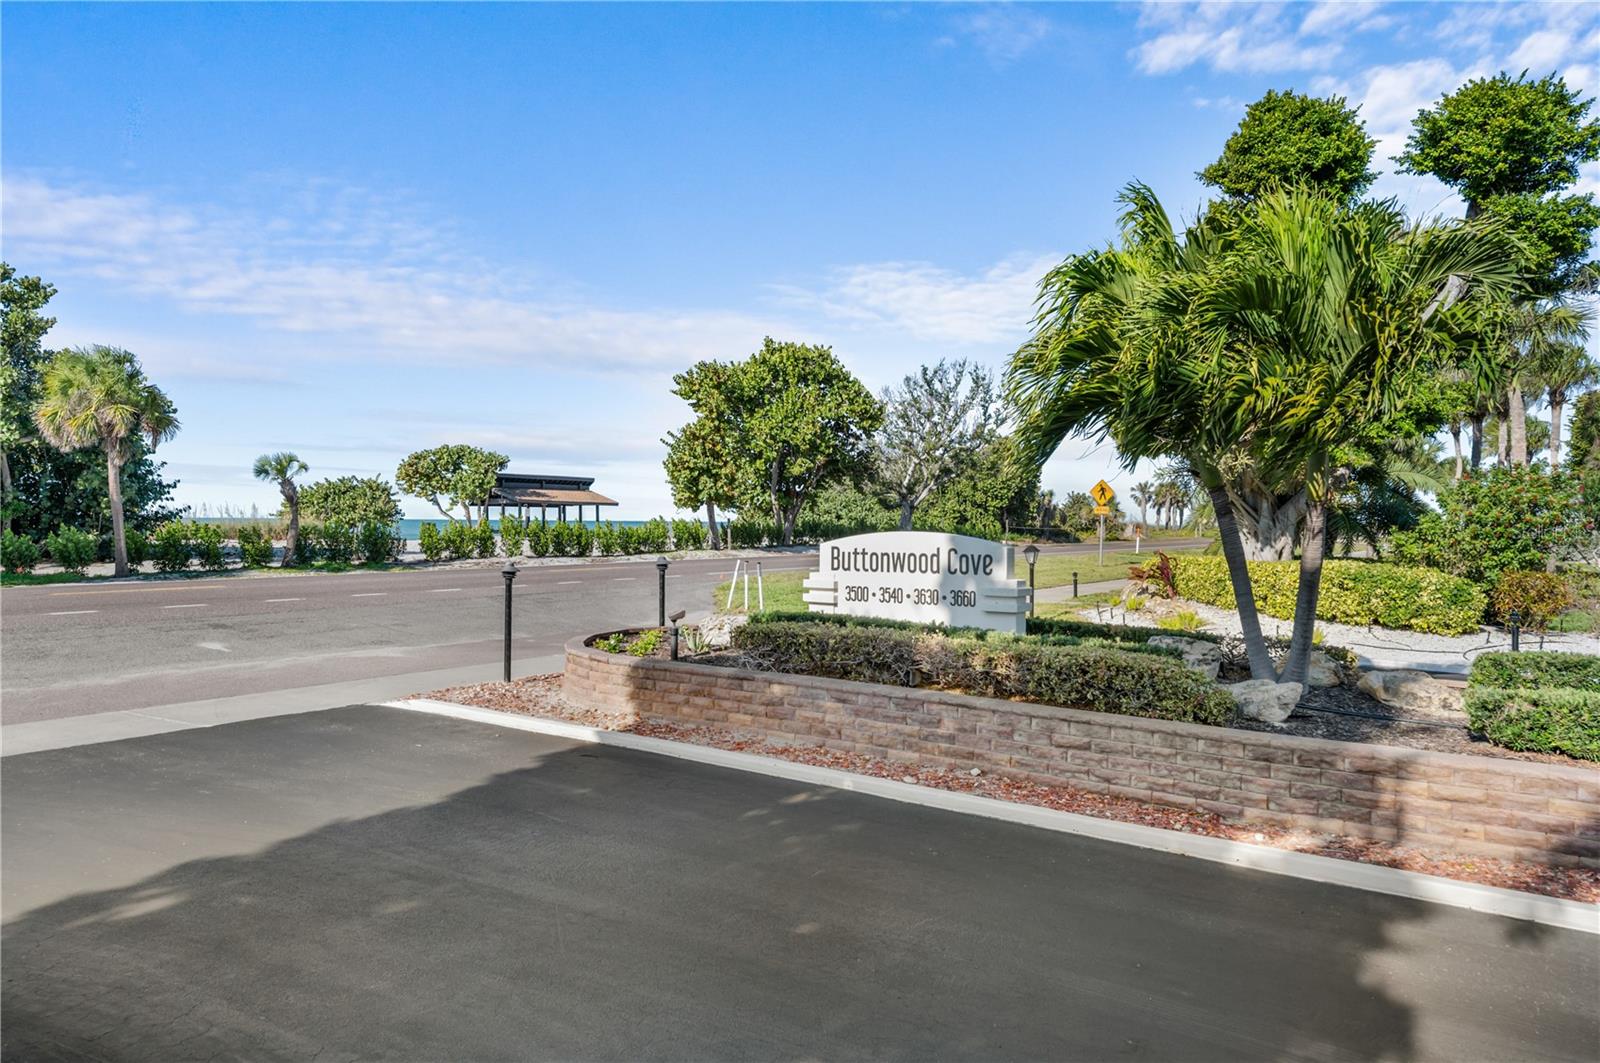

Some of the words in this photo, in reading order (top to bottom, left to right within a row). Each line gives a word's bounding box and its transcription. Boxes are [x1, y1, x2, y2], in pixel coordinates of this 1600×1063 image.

[831, 546, 941, 574] Buttonwood
[947, 547, 993, 576] Cove
[845, 585, 869, 602] 3500
[879, 586, 903, 604] 3540
[913, 588, 939, 606] 3630
[950, 589, 976, 608] 3660
